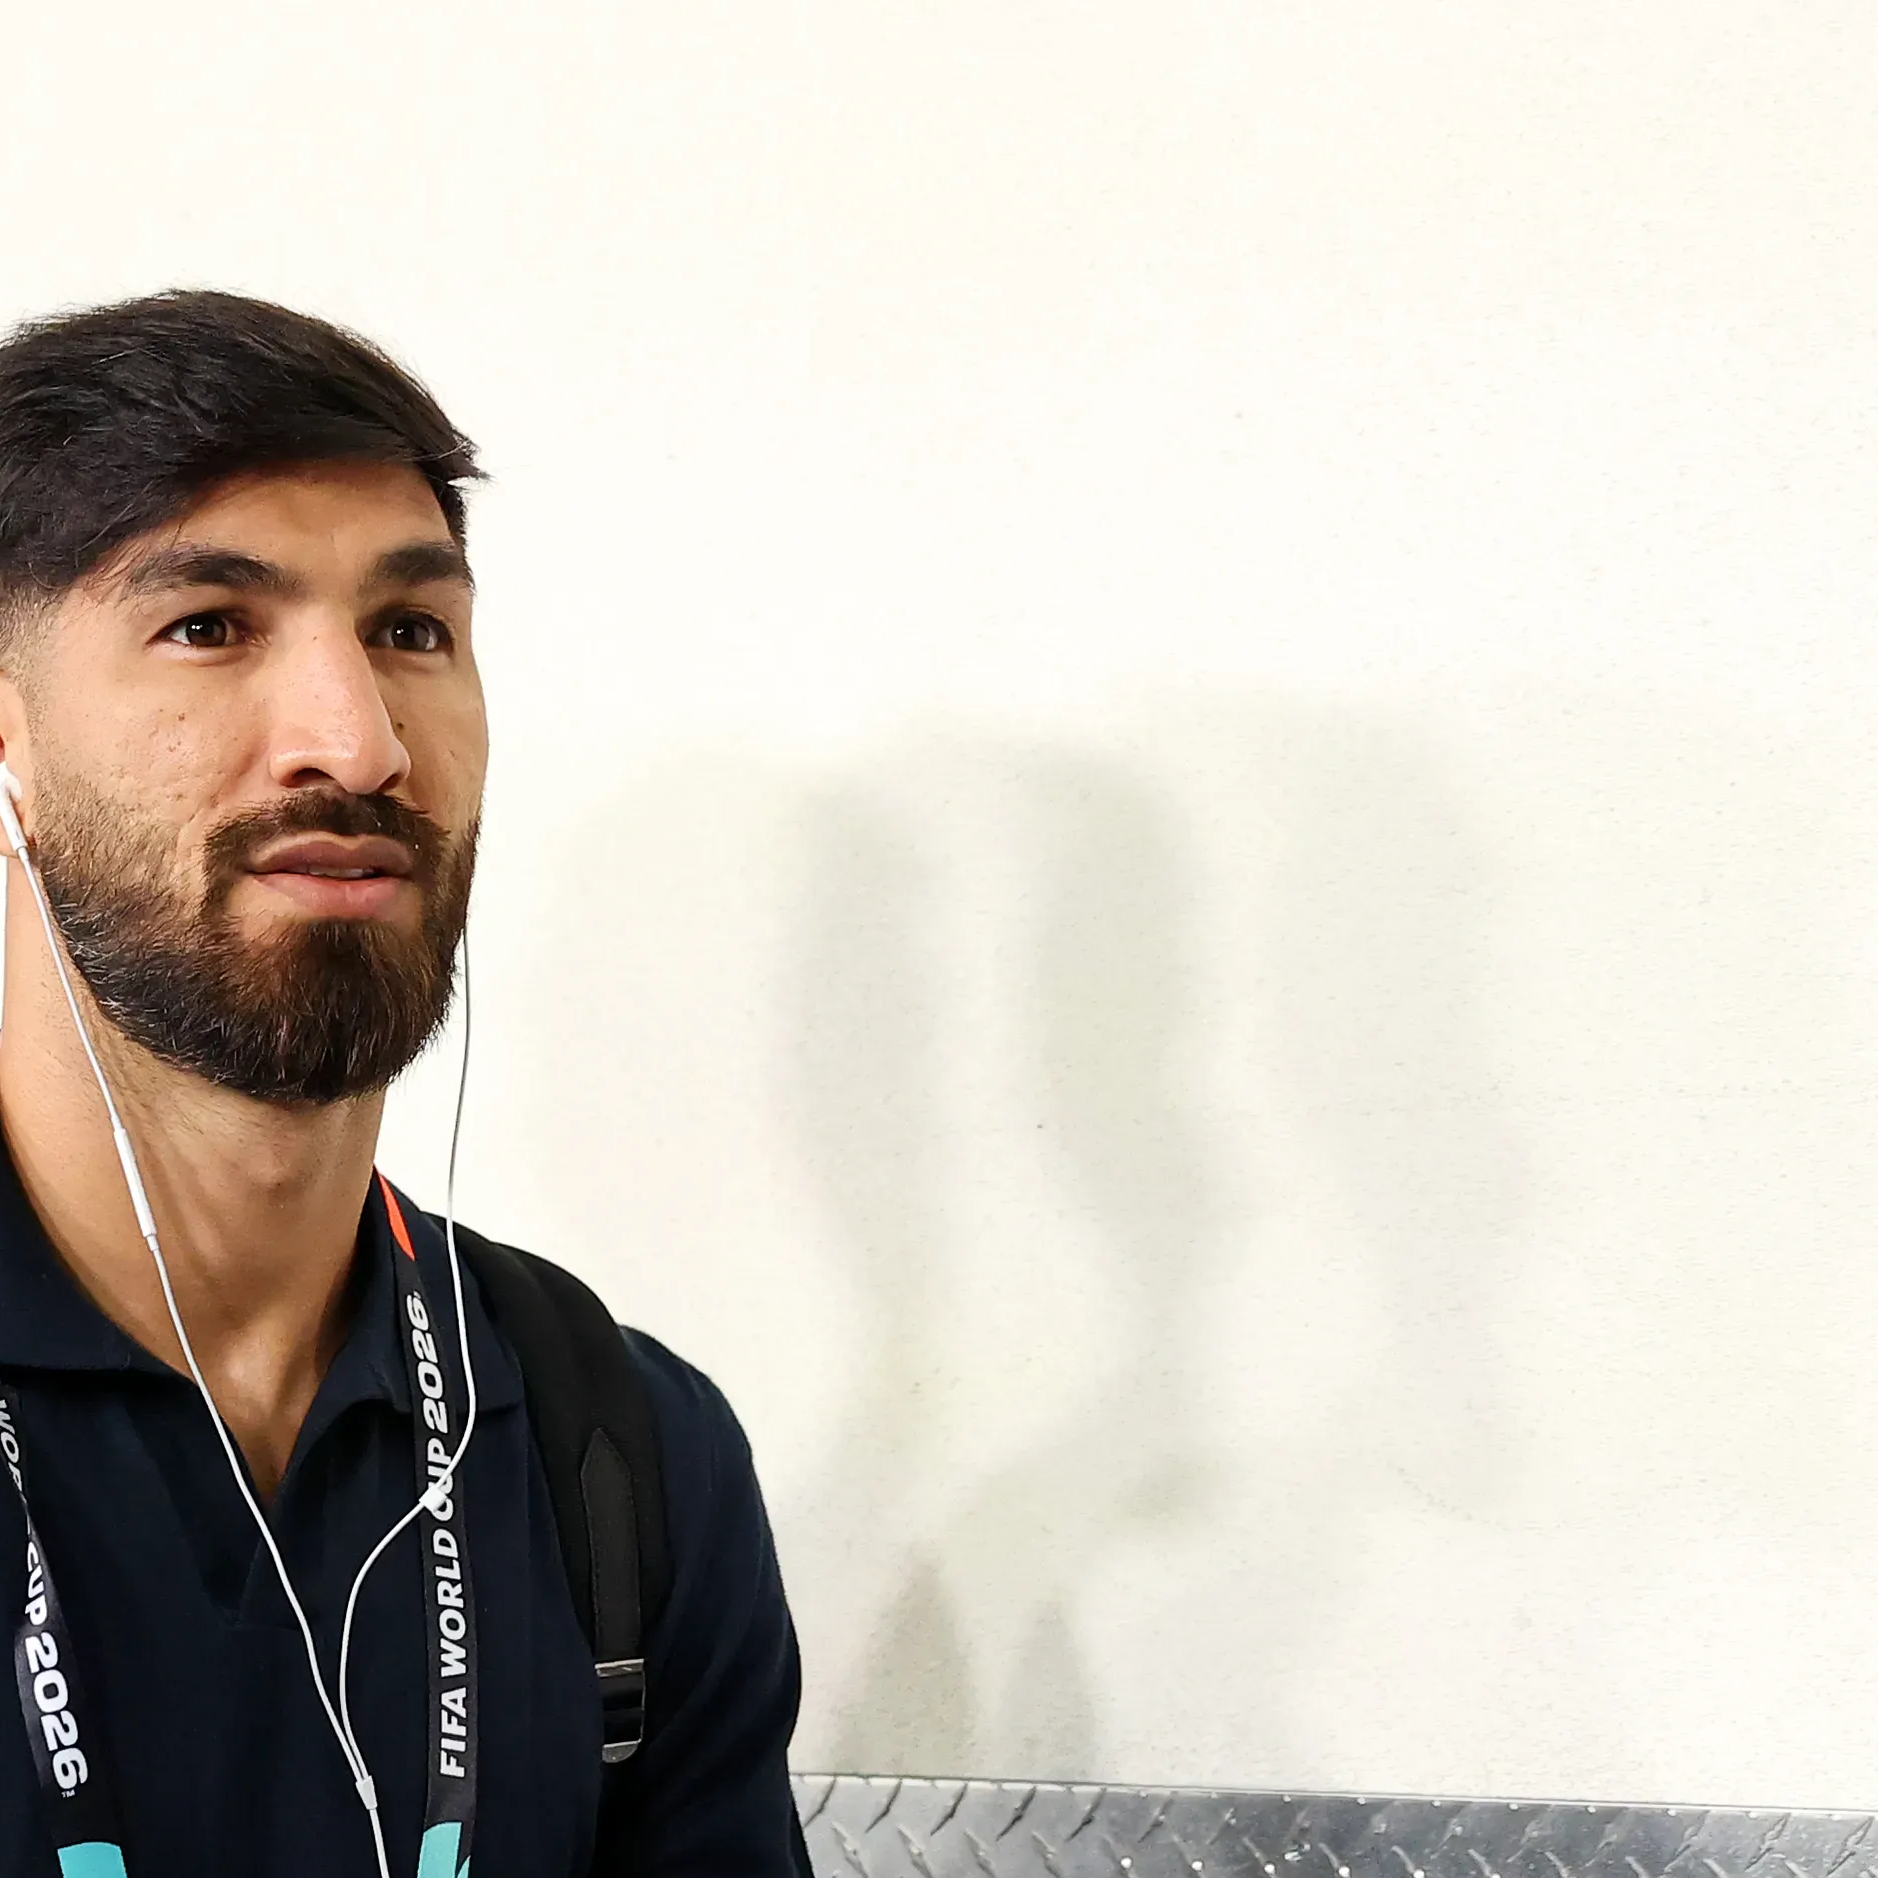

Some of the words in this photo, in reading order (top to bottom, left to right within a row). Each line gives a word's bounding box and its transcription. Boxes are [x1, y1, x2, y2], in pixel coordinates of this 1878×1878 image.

[406, 1294, 449, 1434] 2026
[24, 1541, 48, 1626] CUP
[432, 1528, 467, 1677] WORLD
[25, 1632, 88, 1790] 2026
[439, 1687, 467, 1777] FIFA
